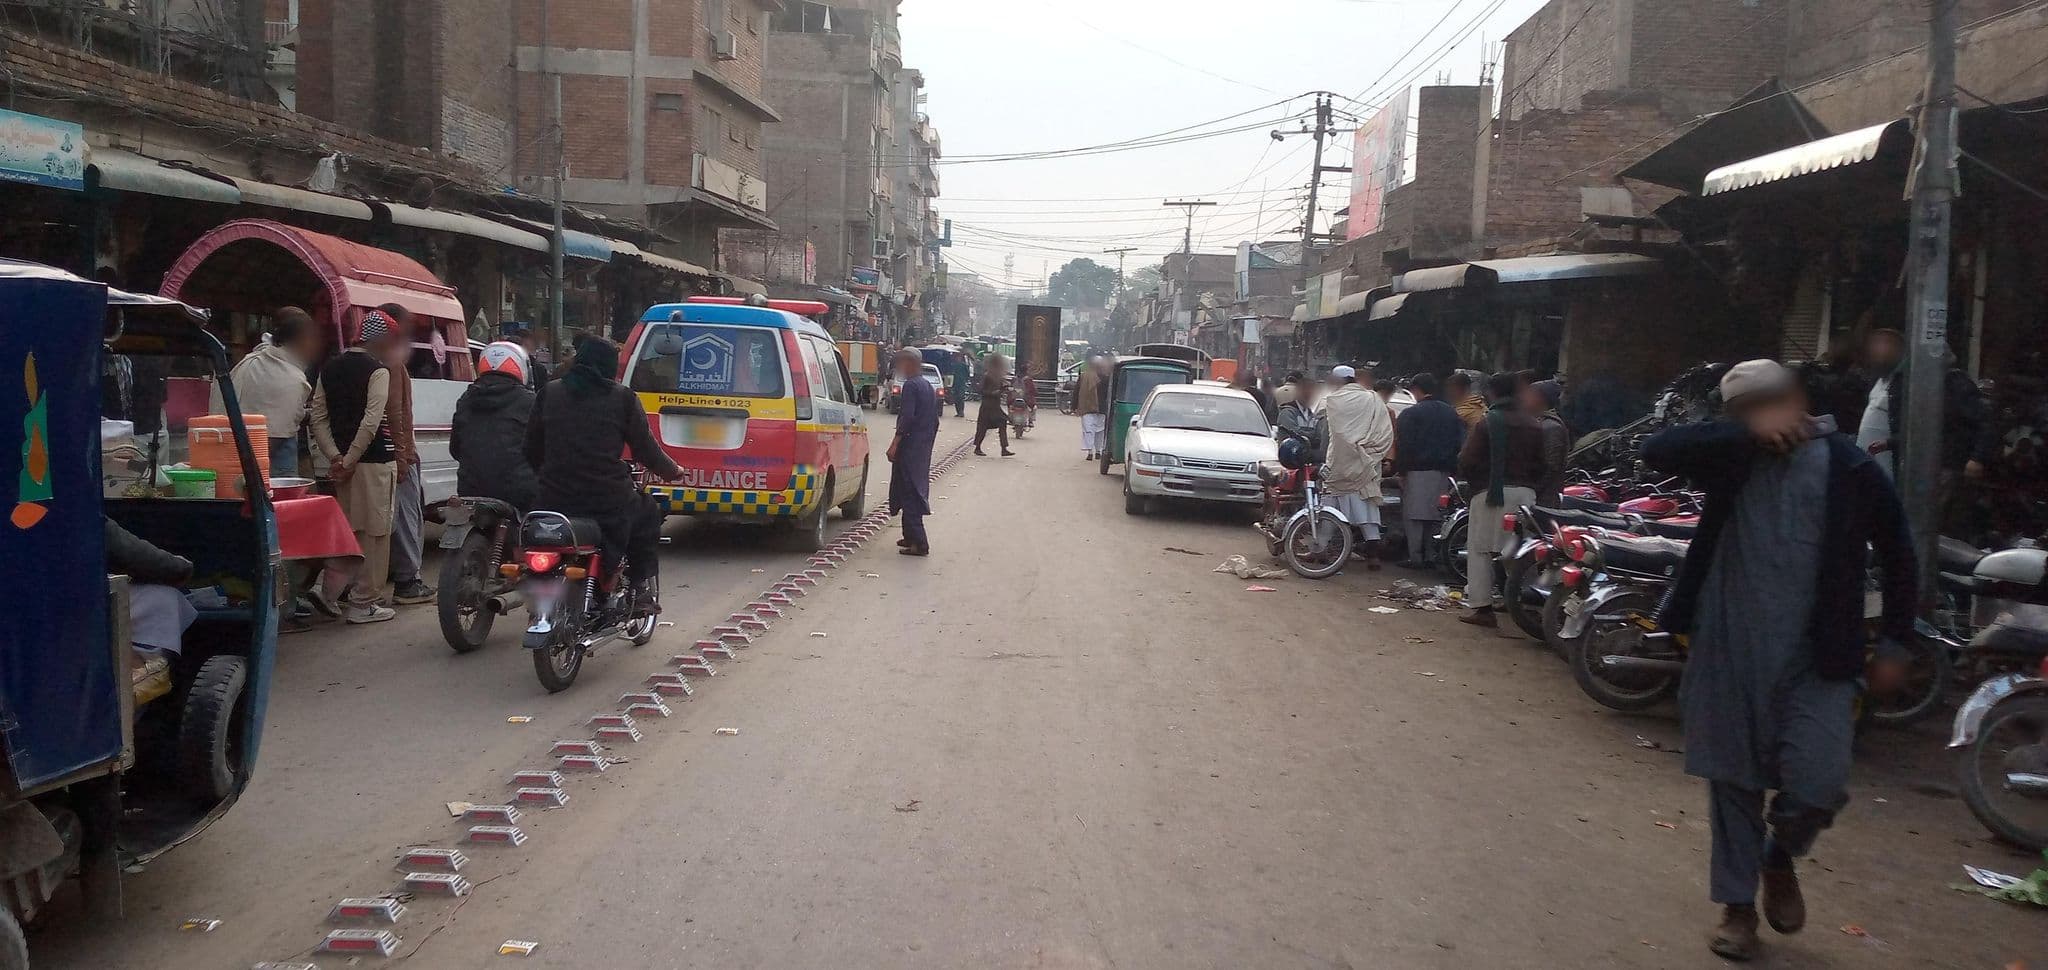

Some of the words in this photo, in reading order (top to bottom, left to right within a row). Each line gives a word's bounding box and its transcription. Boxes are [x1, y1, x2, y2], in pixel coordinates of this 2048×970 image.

[679, 382, 730, 391] ALKHIDMAT
[722, 399, 751, 408] 1023
[643, 469, 767, 489] ULANCE
